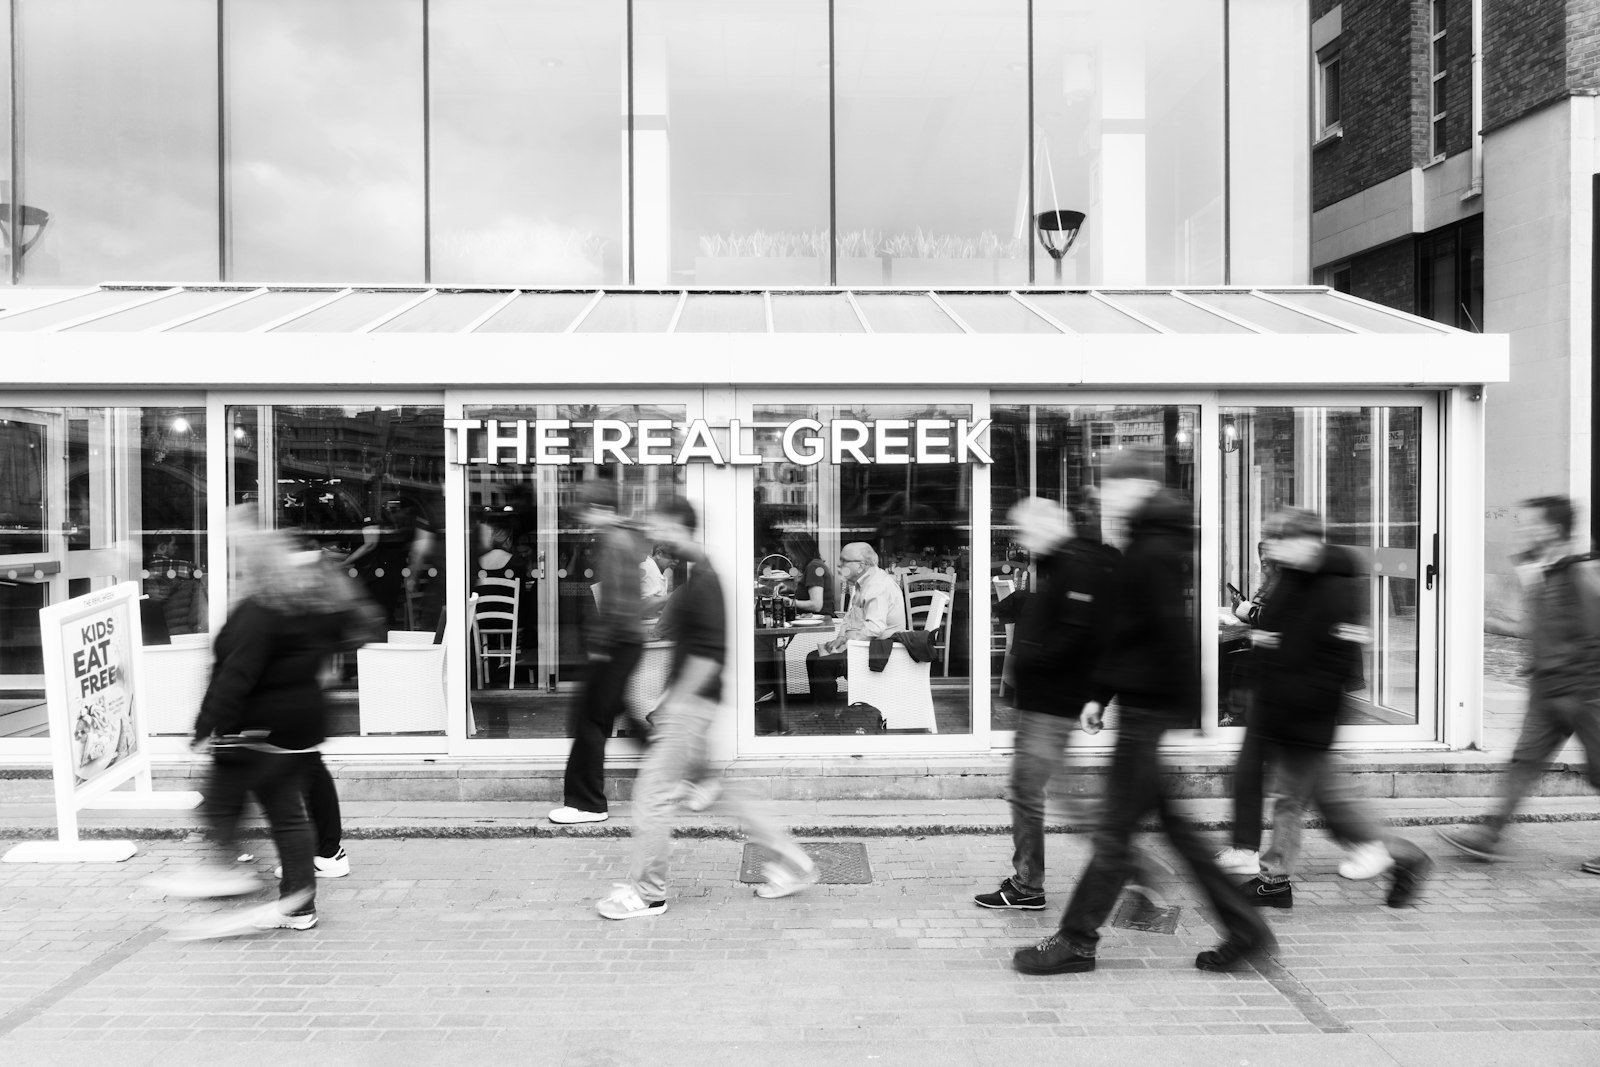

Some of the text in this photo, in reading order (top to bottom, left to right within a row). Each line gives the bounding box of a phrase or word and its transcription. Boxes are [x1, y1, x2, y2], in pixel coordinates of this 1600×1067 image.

[444, 418, 994, 466] THE REAL GREEK
[81, 617, 114, 645] KIDS
[73, 639, 110, 678] EAT
[81, 665, 116, 698] FREE
